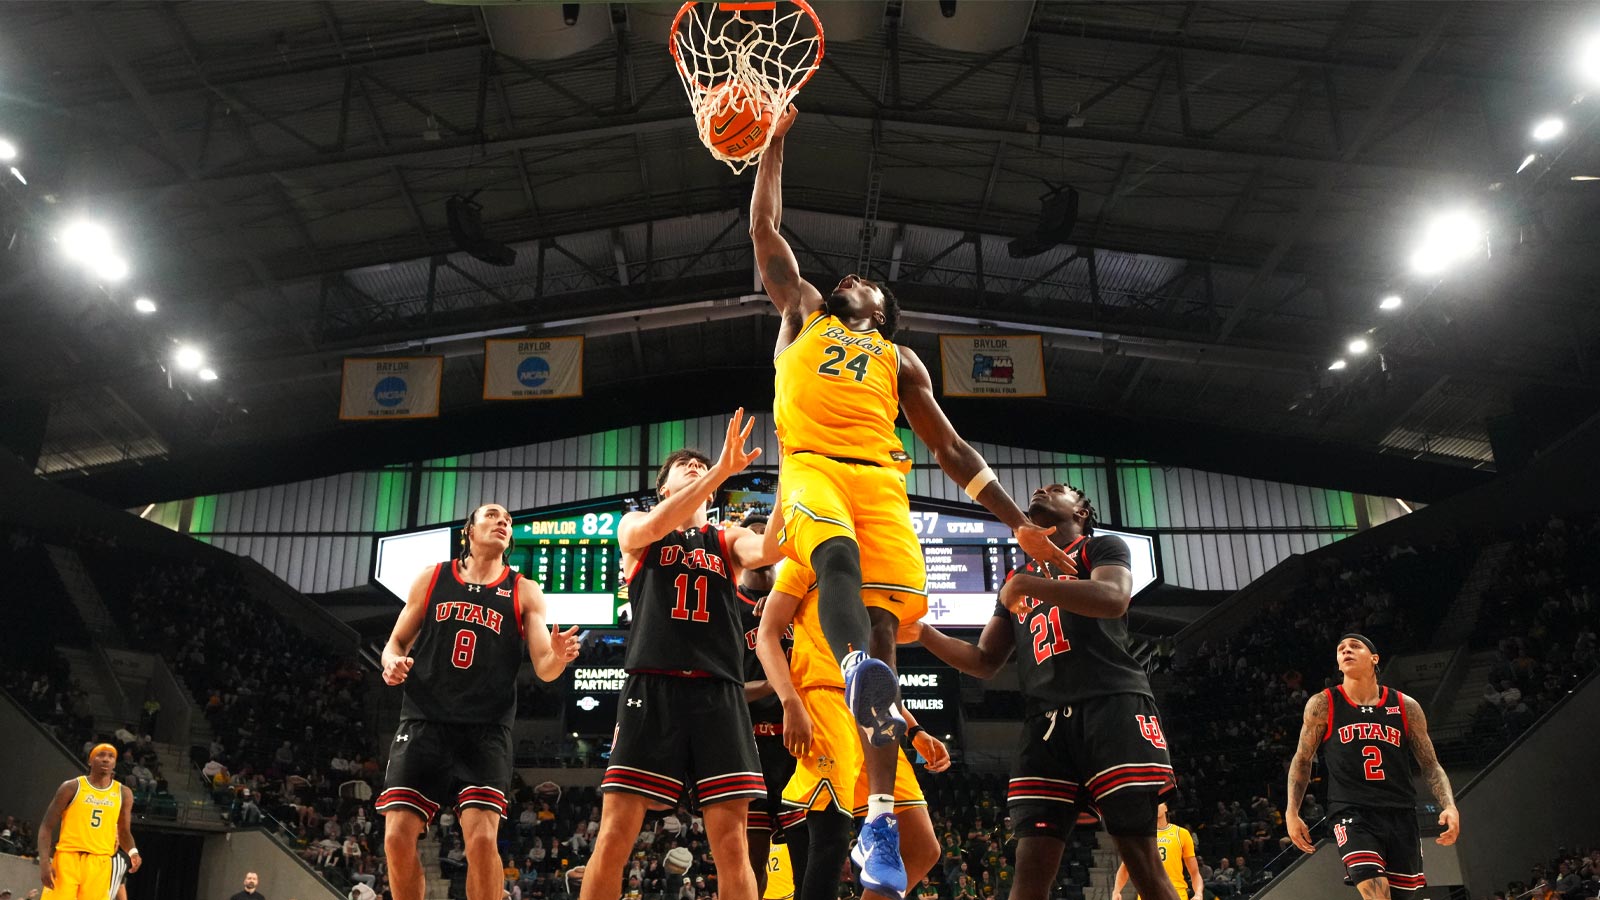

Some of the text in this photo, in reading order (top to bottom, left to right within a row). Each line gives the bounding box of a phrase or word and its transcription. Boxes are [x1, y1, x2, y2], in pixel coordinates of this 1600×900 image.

[726, 125, 763, 153] ELITE
[517, 341, 552, 352] BAYLOR
[820, 326, 883, 356] Baylor
[973, 338, 1008, 349] BAYLOR
[376, 361, 409, 371] BAYLOR
[818, 344, 871, 384] 24
[532, 512, 614, 535] BAYLOR 82
[910, 511, 984, 534] 57 UTAH
[560, 556, 566, 564] 4
[659, 544, 727, 579] UTAH
[925, 547, 953, 555] BROWN
[560, 573, 565, 581] 1
[670, 573, 710, 623] 11
[435, 601, 503, 635] UTAH
[1029, 606, 1072, 666] 21
[452, 629, 477, 670] 8
[574, 668, 629, 679] CHAMPIO
[906, 699, 944, 710] TRAILERS
[1338, 722, 1402, 748] UTAH
[1362, 745, 1386, 780] 2
[91, 809, 103, 828] 5
[767, 856, 781, 873] 12
